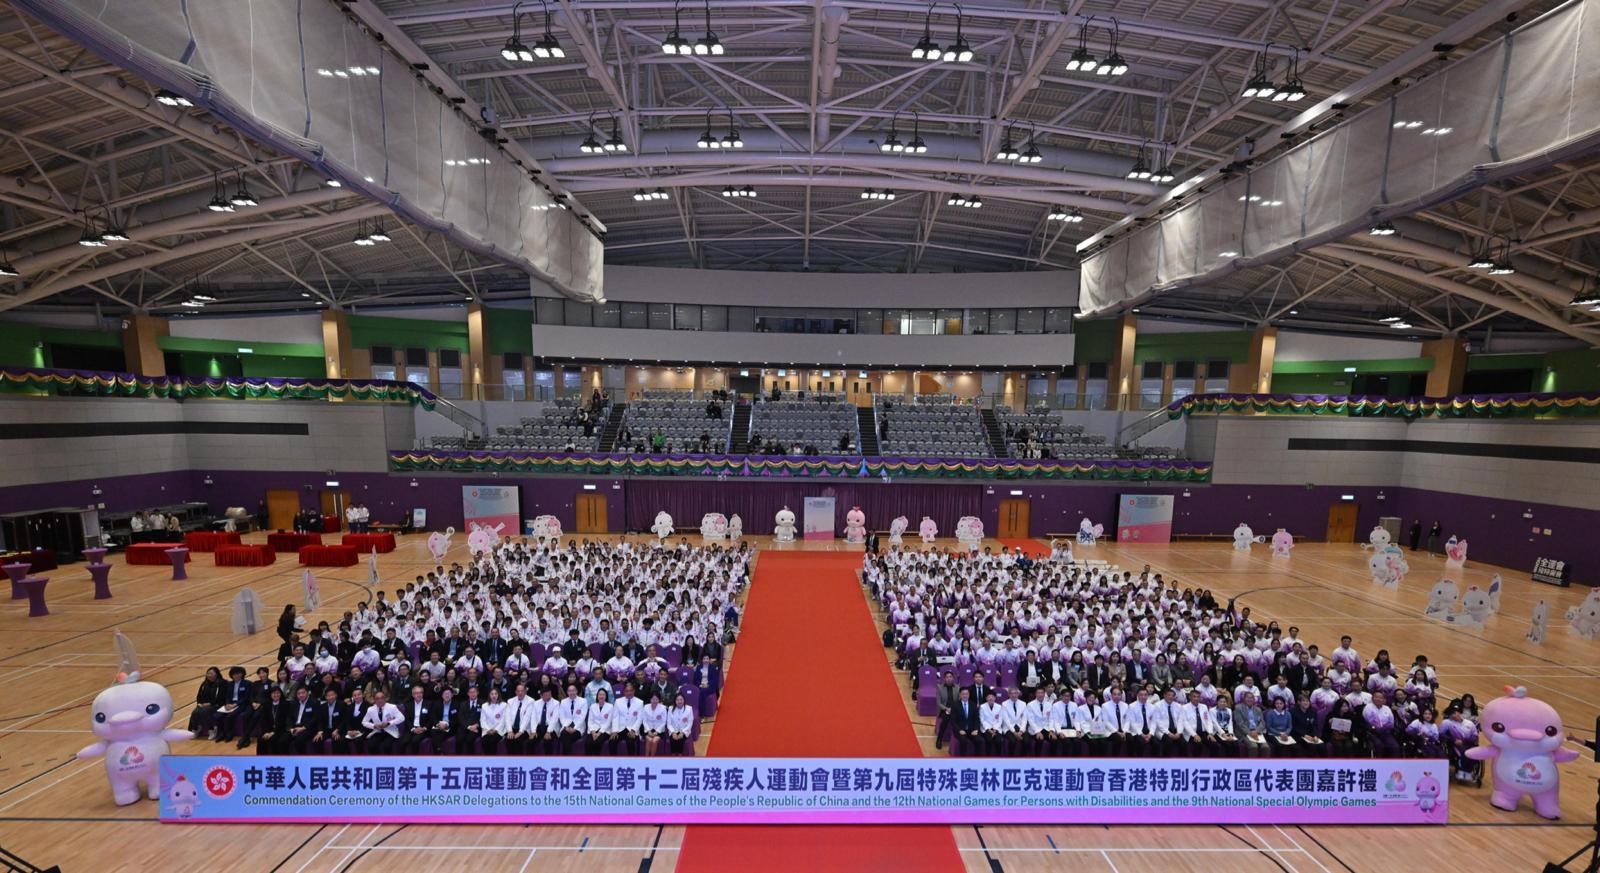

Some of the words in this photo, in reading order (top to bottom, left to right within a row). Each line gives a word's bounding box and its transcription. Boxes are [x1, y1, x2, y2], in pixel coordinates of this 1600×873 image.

[244, 794, 327, 805] Commendation
[329, 794, 385, 808] Ceremony
[388, 794, 399, 805] of
[400, 795, 419, 805] the
[421, 795, 461, 805] HKSAR
[463, 795, 528, 808] Delegations
[530, 796, 542, 806] to
[544, 795, 562, 806] the
[564, 795, 587, 806] 15th
[589, 795, 635, 806] National
[636, 795, 674, 806] Games
[676, 795, 688, 806] of
[689, 795, 707, 806] the
[709, 795, 755, 808] People's
[757, 795, 804, 808] Republic
[806, 795, 818, 806] of
[819, 795, 849, 806] China
[851, 796, 872, 806] and
[873, 796, 891, 806] the
[893, 796, 916, 806] 12th
[917, 796, 962, 806] National
[963, 796, 1001, 806] Games
[1003, 796, 1018, 806] for
[1020, 796, 1064, 806] Persons
[1065, 796, 1089, 806] with
[1091, 796, 1148, 806] Disabilities
[1150, 796, 1170, 806] and
[1172, 796, 1190, 806] the
[1191, 796, 1209, 806] 9th
[1210, 796, 1254, 806] National
[1256, 796, 1295, 809] Special
[1296, 796, 1338, 809] Olympic
[1340, 796, 1377, 806] Games
